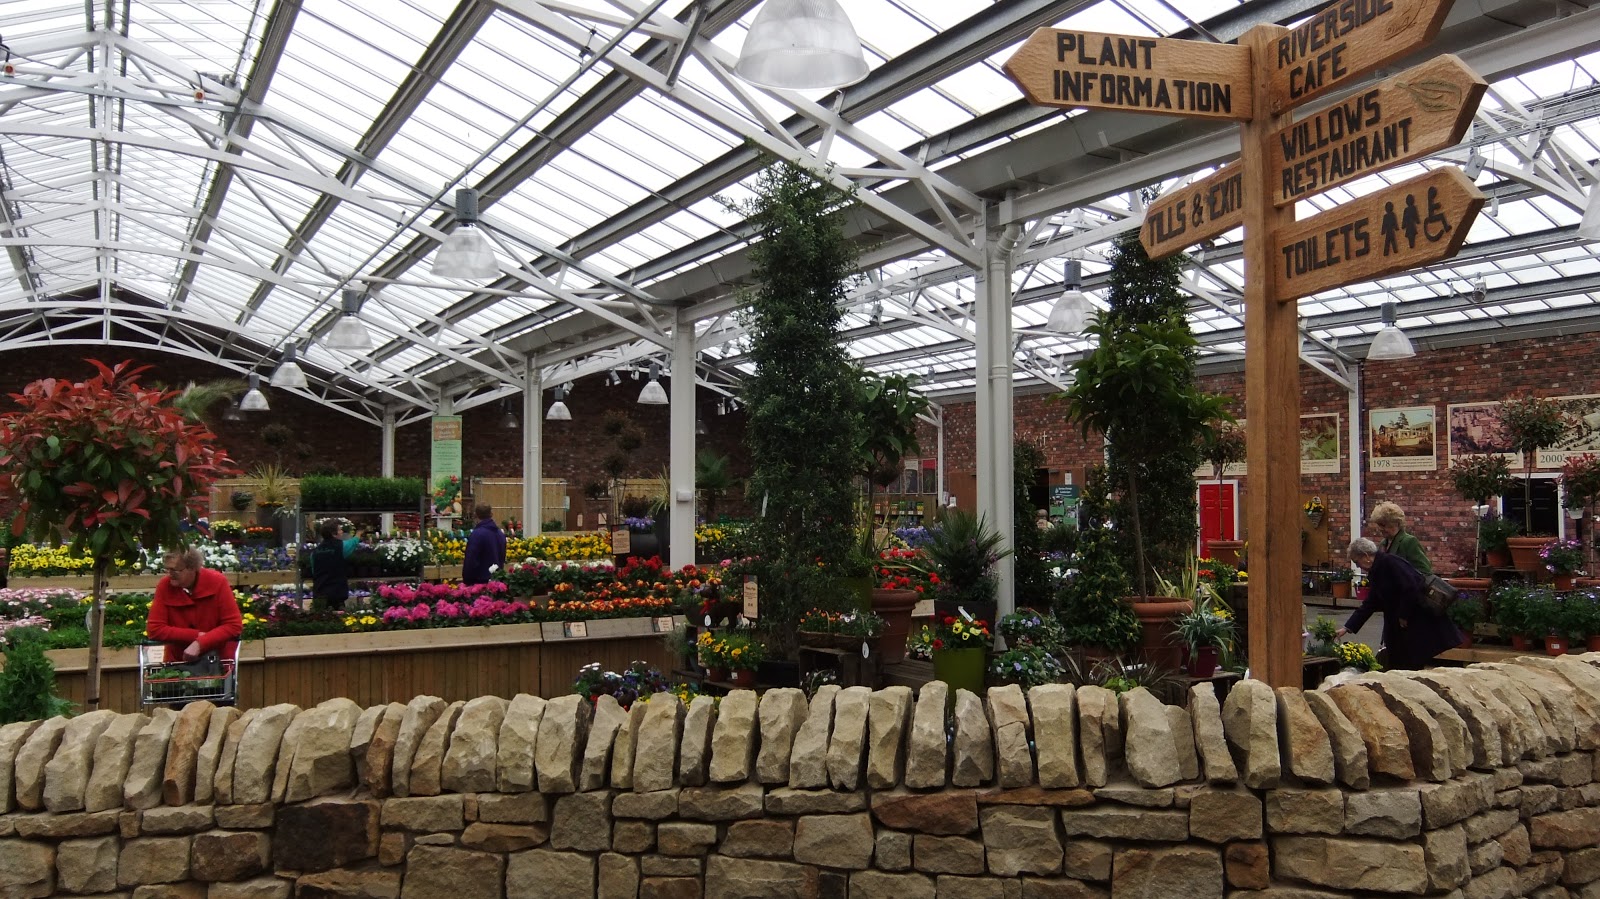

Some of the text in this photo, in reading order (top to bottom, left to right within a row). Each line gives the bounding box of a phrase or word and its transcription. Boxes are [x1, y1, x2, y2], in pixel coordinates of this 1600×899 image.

[1057, 32, 1156, 70] PLANT
[1290, 42, 1347, 99] CAFE
[1053, 69, 1232, 113] INFORMATION
[1280, 89, 1382, 162] WILLOWS
[1282, 117, 1412, 199] RESTAURANT
[1148, 173, 1242, 247] TILLS & EXIT
[1282, 217, 1370, 279] TOILETS
[1373, 459, 1391, 468] 1978
[1540, 453, 1566, 463] 2000'
